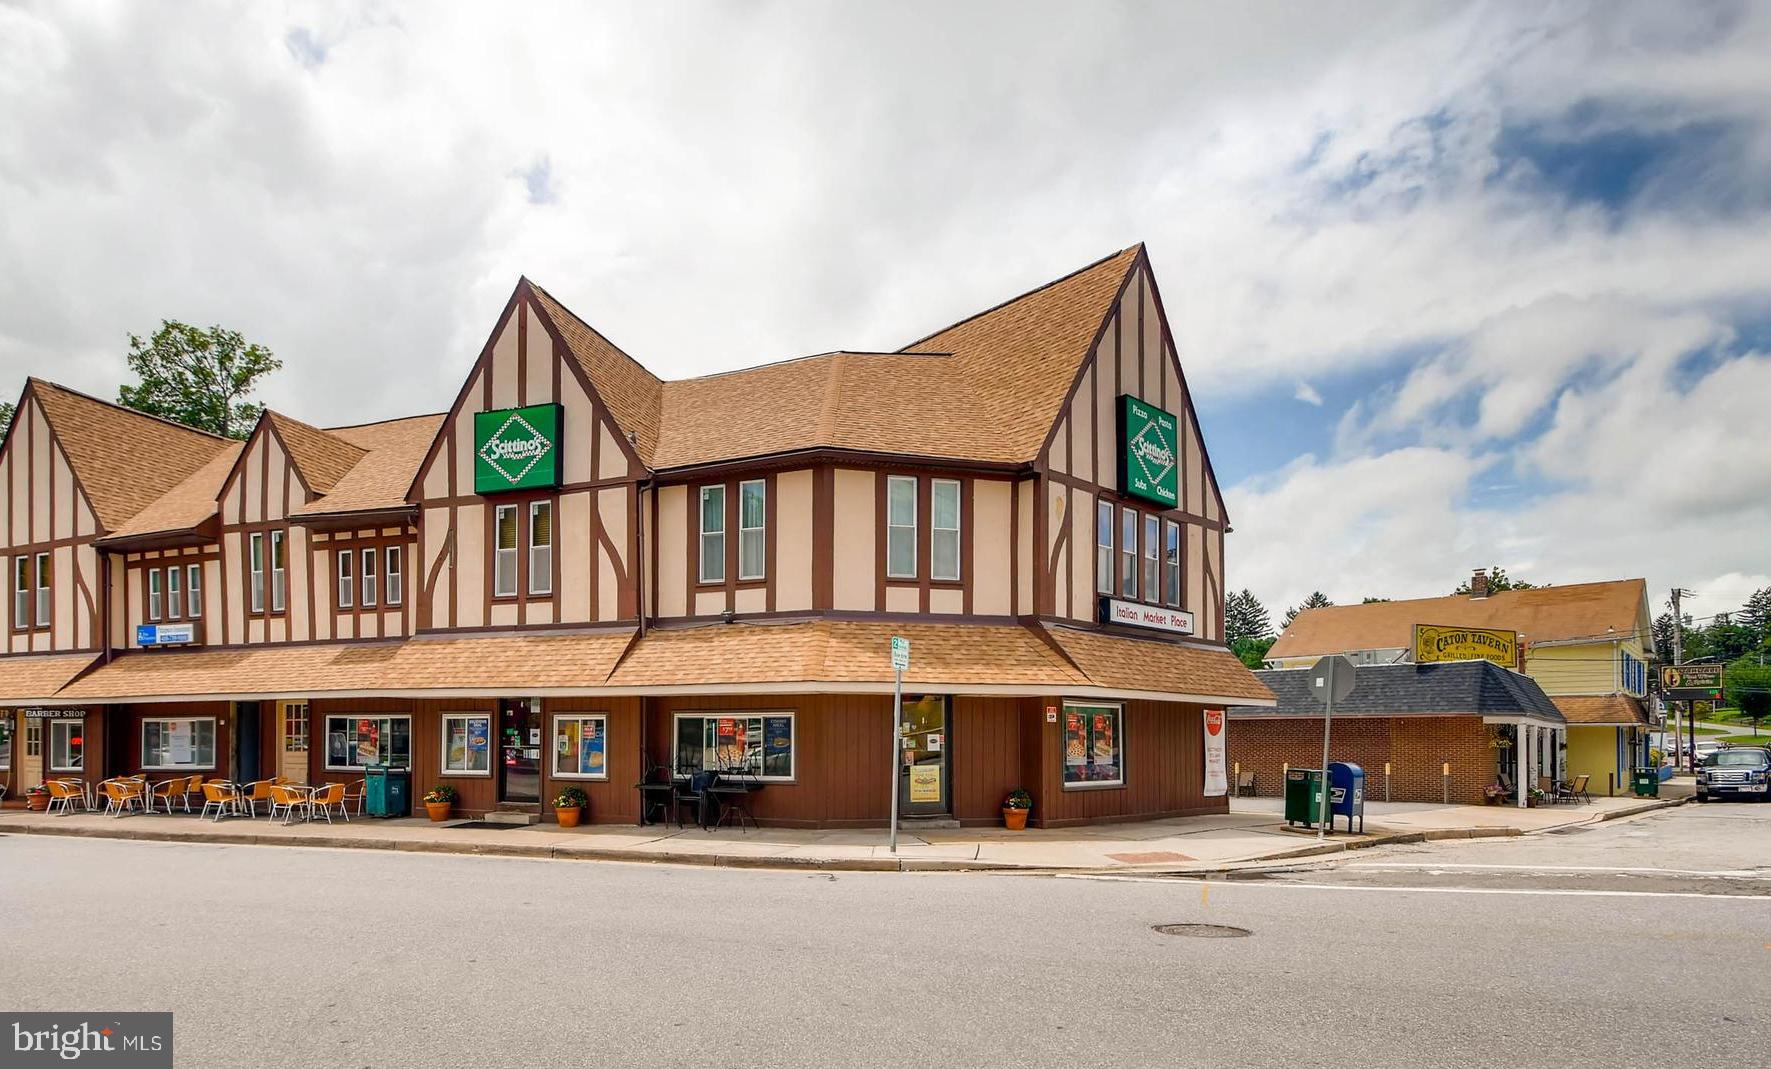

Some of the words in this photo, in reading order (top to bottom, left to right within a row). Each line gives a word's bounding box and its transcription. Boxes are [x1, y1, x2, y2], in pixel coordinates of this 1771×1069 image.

[1132, 404, 1148, 419] Pizza
[1158, 416, 1172, 430] Pasta
[1135, 478, 1147, 490] Subs
[1156, 486, 1175, 500] Chicken
[1116, 605, 1138, 621] Italian
[1143, 611, 1166, 625] Market
[1170, 615, 1187, 628] Place
[1436, 633, 1468, 652] CATON
[1471, 633, 1509, 654] TAVERN
[26, 710, 61, 718] BARBER
[62, 710, 86, 718] SHOP
